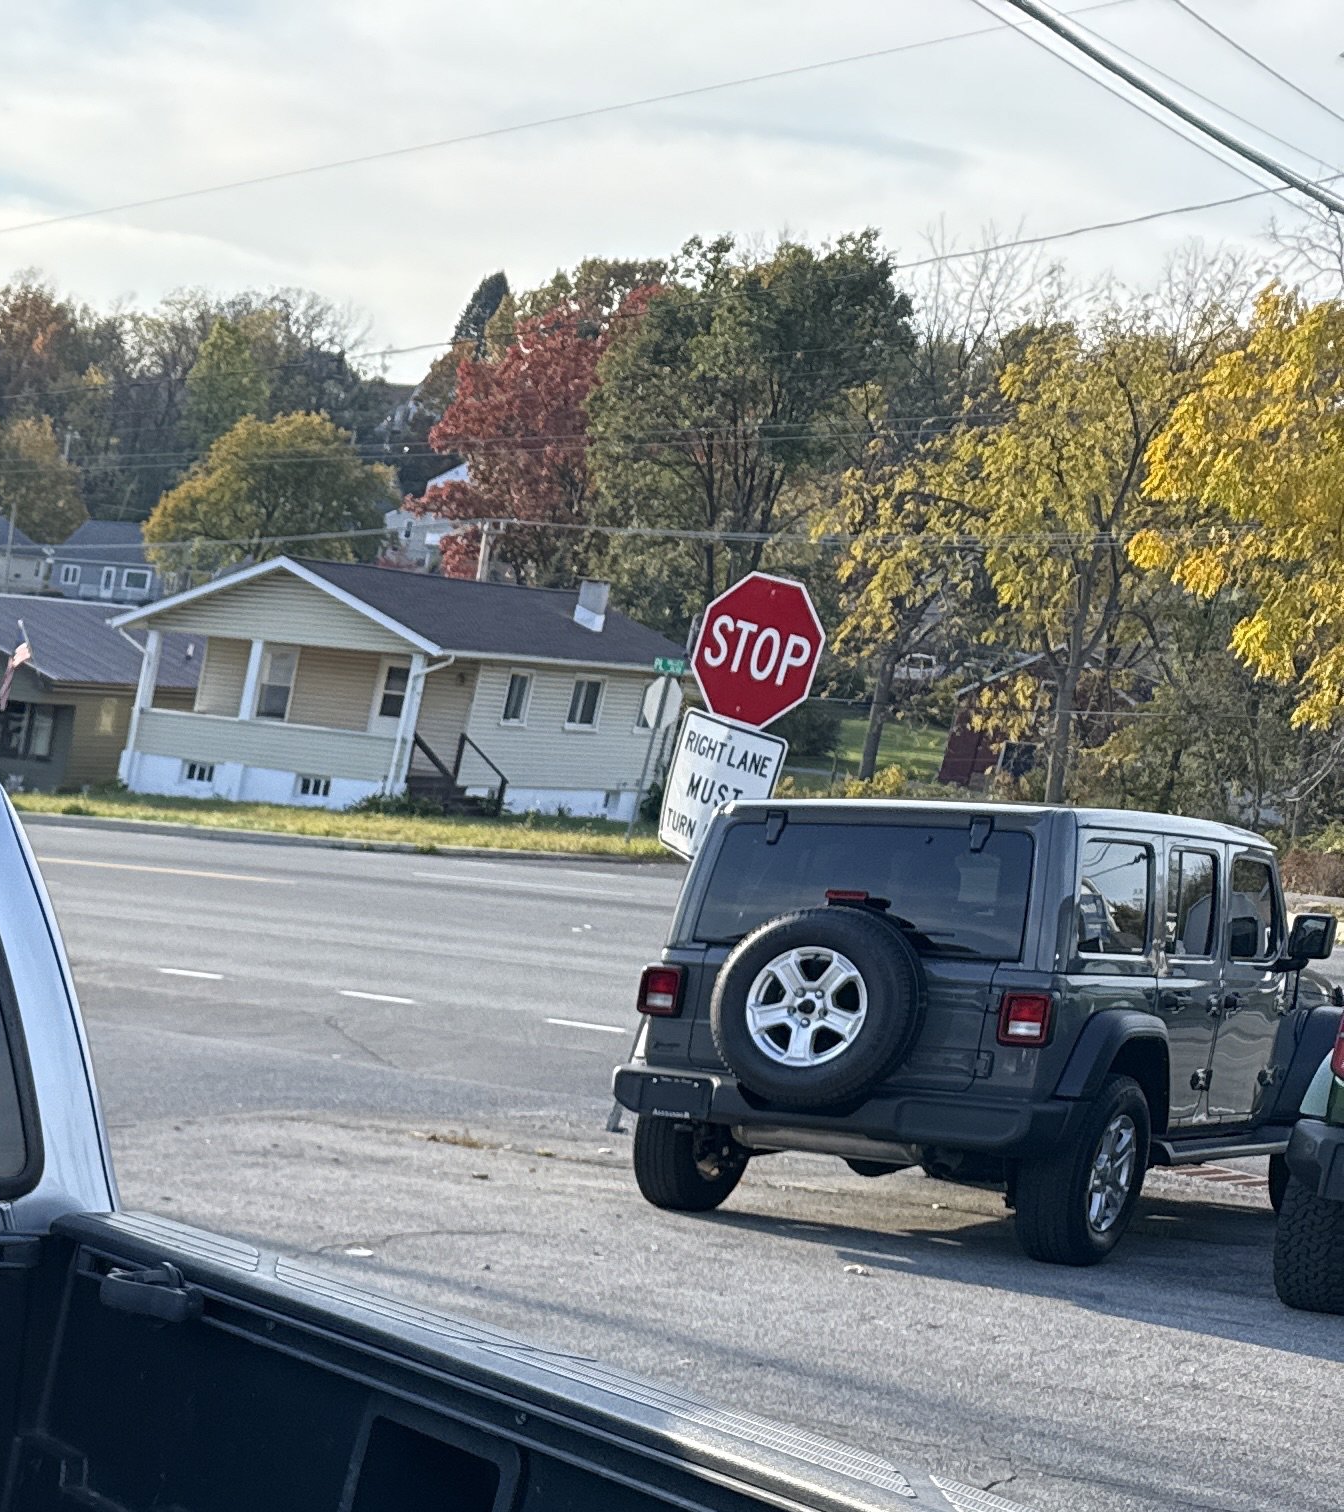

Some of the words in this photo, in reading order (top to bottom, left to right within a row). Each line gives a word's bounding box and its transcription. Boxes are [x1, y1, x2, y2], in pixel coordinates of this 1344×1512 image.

[704, 614, 812, 687] STOP
[685, 730, 727, 763] RIGHT
[726, 746, 772, 779] LANE
[686, 772, 743, 807] MUST
[666, 807, 697, 839] TURN
